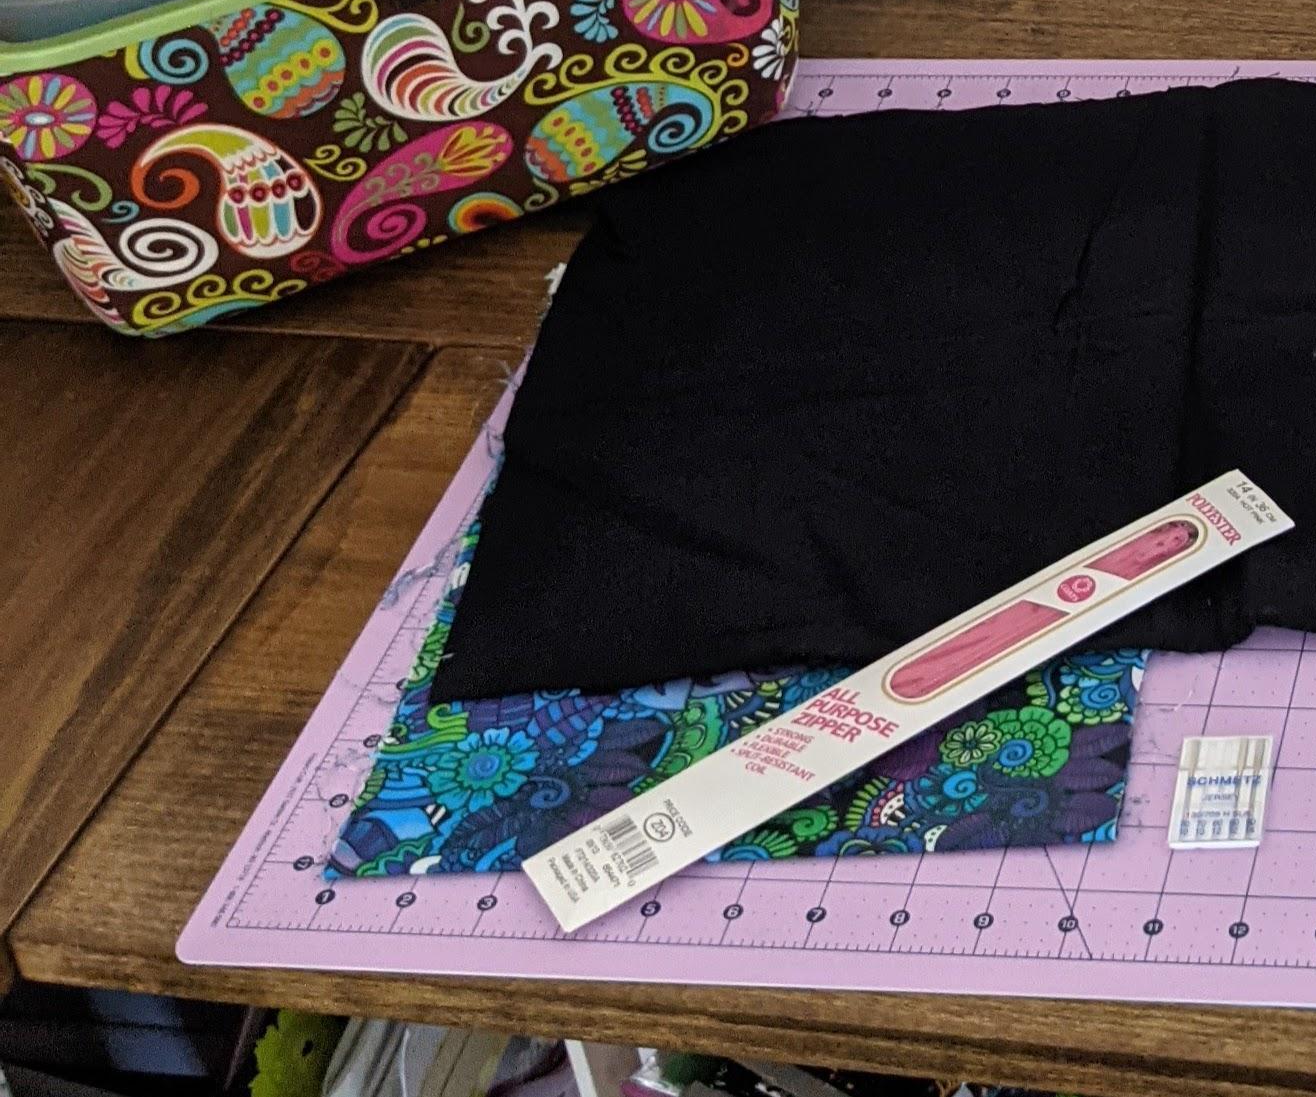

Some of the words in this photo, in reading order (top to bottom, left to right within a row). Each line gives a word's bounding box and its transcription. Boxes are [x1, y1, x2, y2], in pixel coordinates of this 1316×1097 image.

[1185, 492, 1242, 546] POLYESTER
[821, 687, 860, 705] ALL
[791, 712, 862, 743] ZIPPER
[806, 699, 899, 738] PURPOSE
[760, 735, 808, 753] DURABLE
[773, 727, 815, 745] STRONG
[749, 742, 792, 759] FLEXIBLE
[738, 748, 816, 782] SPLIT-RESISTANT
[1187, 774, 1262, 787] SCHMETZ
